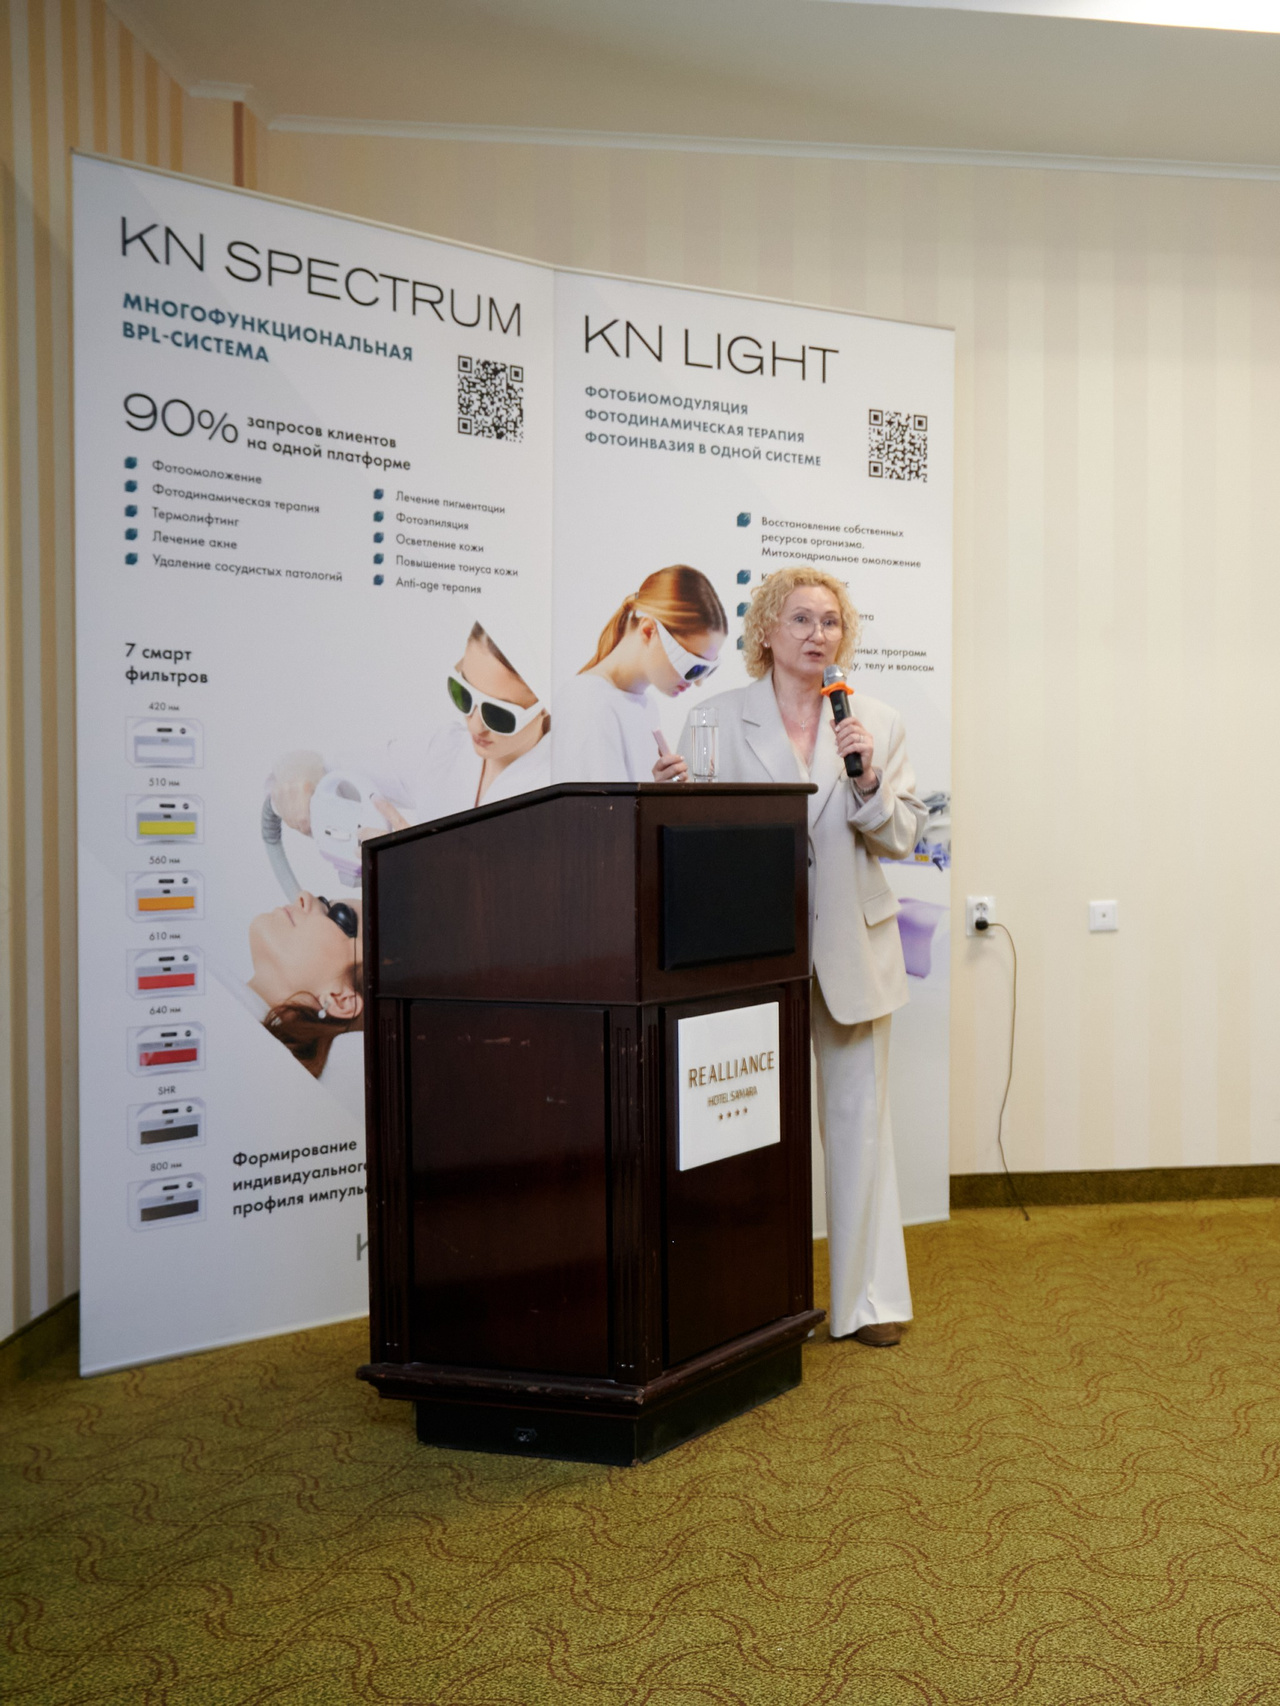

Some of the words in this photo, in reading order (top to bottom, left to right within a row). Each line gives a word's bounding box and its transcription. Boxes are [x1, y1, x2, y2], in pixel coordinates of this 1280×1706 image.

[121, 216, 204, 272] KN
[225, 240, 521, 336] SPECTRUM
[122, 292, 412, 361] МНОГОФУНКЦИОНАЛЬНАЯ
[585, 315, 662, 362] KN
[684, 328, 839, 383] LIGHT
[585, 385, 748, 415] ФОТОБИОМОДУЛЯЦИЯ
[123, 393, 238, 444] 90%
[585, 408, 743, 436] ФОТОДИНАМИЧЕСКАЯ
[747, 427, 804, 442] ТЕРАПИЯ
[247, 417, 323, 437] запросов
[327, 429, 396, 448] клиентов
[247, 439, 267, 450] на
[272, 442, 322, 458] одной
[327, 450, 411, 471] платформе
[585, 431, 694, 453] ФОТОИНВАЗИЯ
[699, 443, 706, 454] В
[710, 445, 761, 460] ОДНОЙ
[765, 451, 820, 466] СИСТЕМЕ
[152, 459, 262, 484] Фотоомоложение
[152, 483, 271, 508] Фотодинамическая
[274, 501, 320, 513] терапия
[396, 490, 440, 506] Лечение
[443, 499, 505, 514] пигментации
[152, 506, 239, 527] Термолифтинг
[396, 512, 469, 530] Фотоэпиляция
[761, 516, 841, 532] Восстановление
[843, 524, 903, 537] собственных
[152, 530, 205, 547] Лечение
[209, 540, 237, 550] акне
[395, 533, 456, 550] Осветление
[459, 544, 484, 552] кожи
[761, 534, 808, 545] ресурсов
[810, 538, 864, 549] организма.
[152, 554, 211, 570] Удаление
[214, 563, 282, 576] сосудистых
[285, 570, 342, 582] патологий
[396, 554, 456, 571] Повышение
[458, 564, 491, 576] тонуса
[494, 568, 518, 576] кожи
[761, 547, 859, 563] Митохондриальное
[862, 557, 921, 568] омоложение
[395, 577, 439, 593] Anti-age
[442, 583, 481, 594] терапия
[125, 642, 136, 657] 7
[142, 648, 192, 664] смарт
[881, 649, 927, 659] программ
[125, 665, 208, 687] фильтров
[865, 663, 885, 672] телу
[148, 702, 166, 711] 420
[149, 777, 167, 787] 510
[149, 855, 167, 865] 560
[149, 931, 167, 941] 610
[149, 1005, 167, 1015] 640
[689, 1051, 774, 1088] REALLIANCE
[158, 1085, 176, 1096] SHR
[708, 1093, 729, 1106] HOTEL
[233, 1141, 357, 1166] Формирование
[150, 1161, 168, 1172] 800
[233, 1195, 304, 1218] профиля
[309, 1185, 367, 1203] импуль
